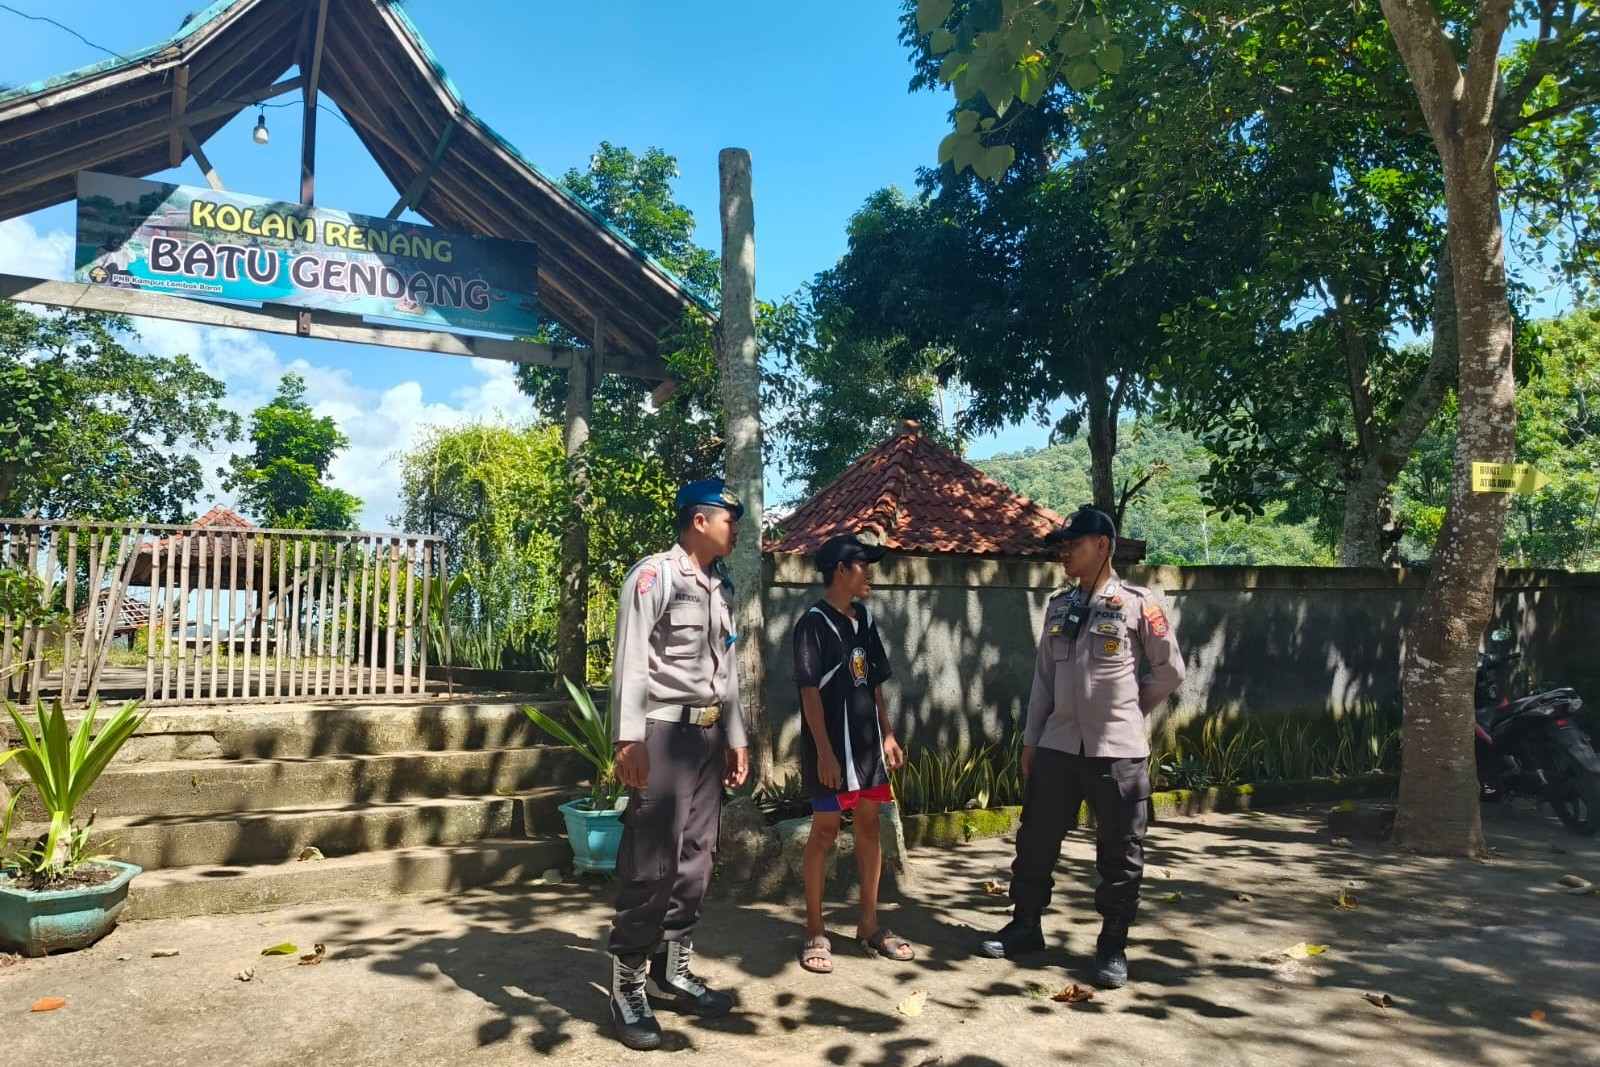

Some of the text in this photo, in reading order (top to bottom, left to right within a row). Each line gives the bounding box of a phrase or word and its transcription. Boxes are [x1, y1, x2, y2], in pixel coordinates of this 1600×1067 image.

[190, 199, 453, 263] KOLAM RENANG
[132, 275, 165, 288] Kampus
[166, 278, 198, 290] Lombok
[199, 283, 223, 293] Barat
[149, 235, 491, 314] BATU GENDANG
